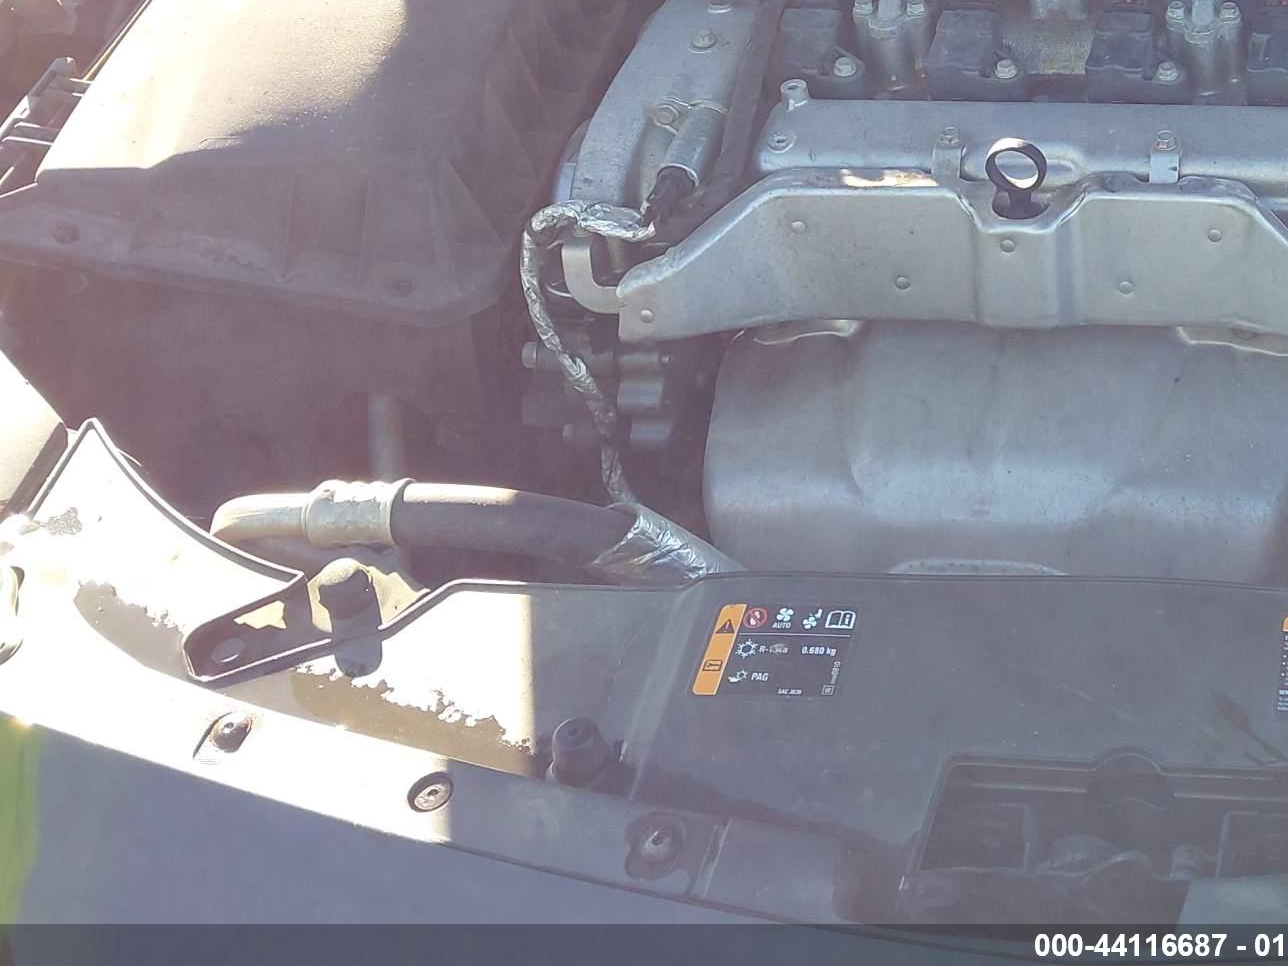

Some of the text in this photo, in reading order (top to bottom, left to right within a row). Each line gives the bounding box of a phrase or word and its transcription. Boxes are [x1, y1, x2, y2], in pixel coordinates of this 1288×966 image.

[771, 621, 793, 629] AUTO
[825, 647, 837, 657] kg
[750, 672, 769, 682] PAG
